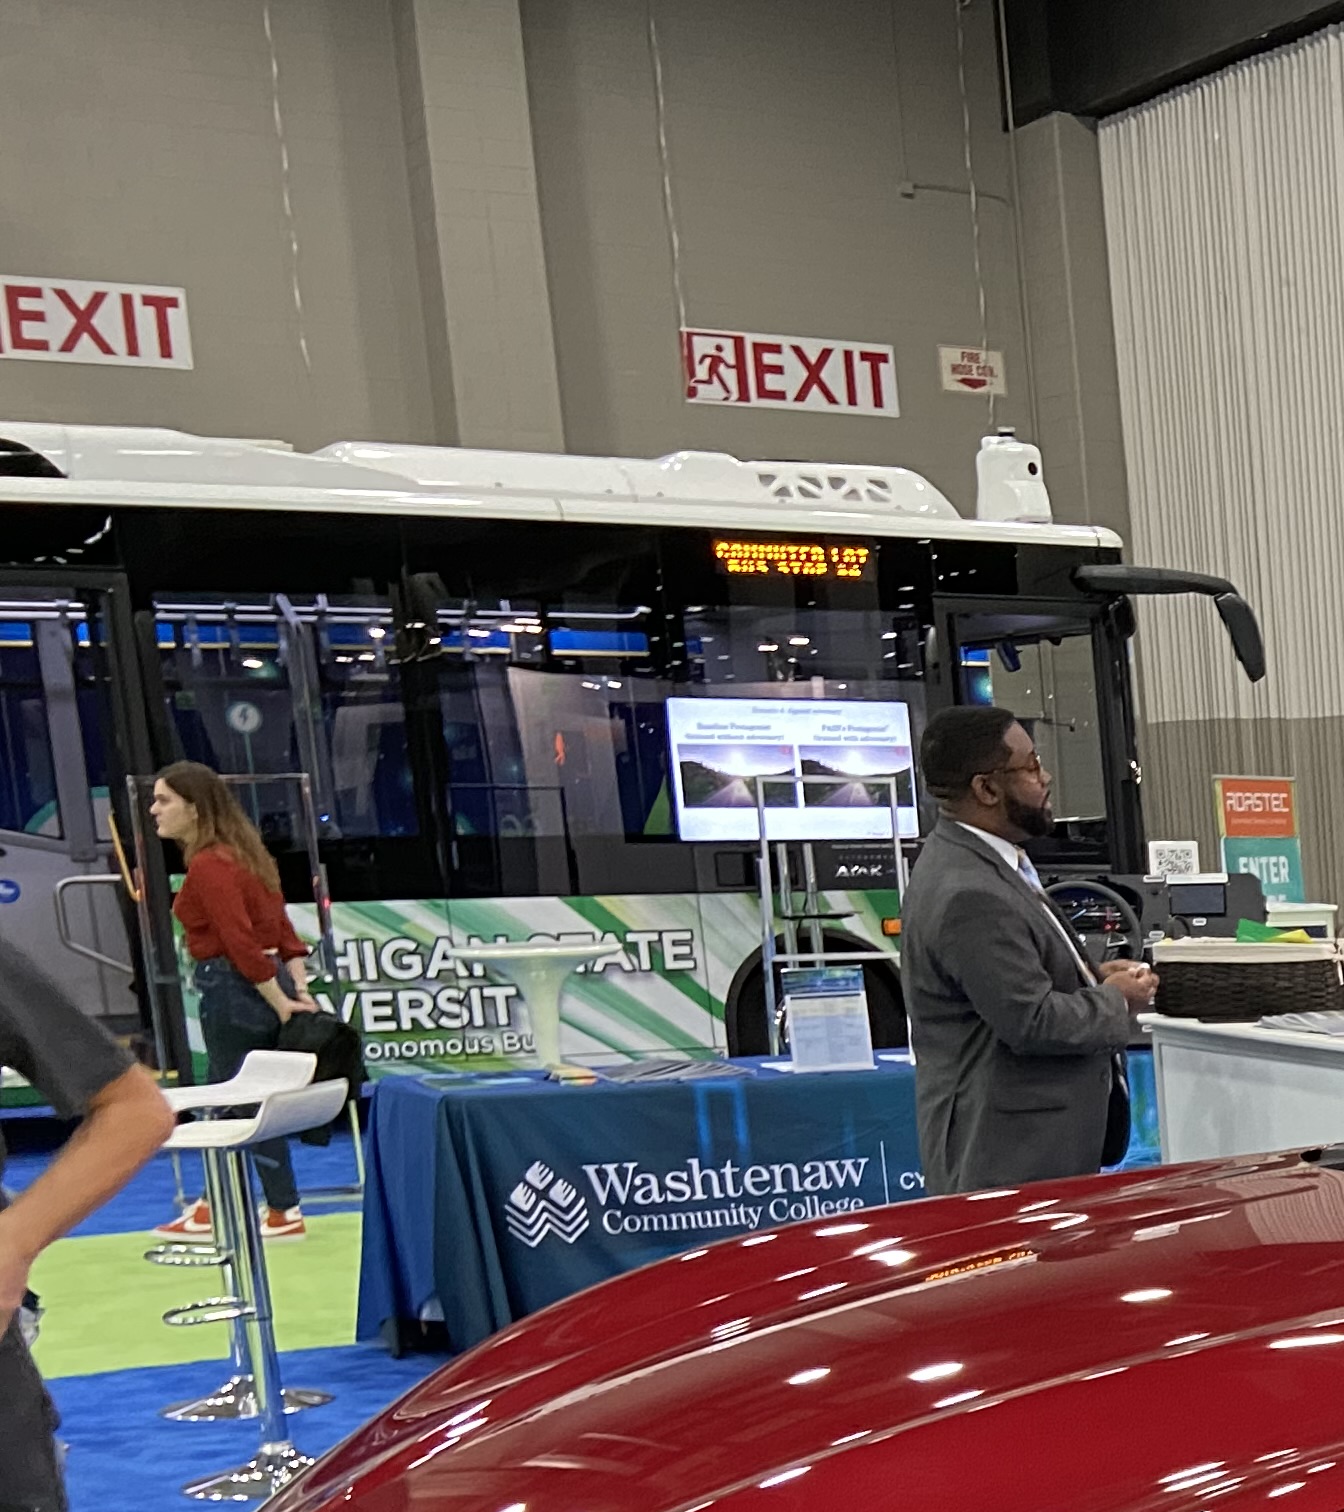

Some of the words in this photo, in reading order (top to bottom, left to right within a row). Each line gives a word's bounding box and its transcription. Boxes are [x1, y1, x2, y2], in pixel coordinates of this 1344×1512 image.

[4, 284, 180, 359] EXIT
[752, 341, 889, 408] EXIT
[1238, 855, 1291, 884] ENTER
[582, 1157, 869, 1207] Washtenaw
[602, 1206, 765, 1236] Community
[769, 1196, 865, 1222] College
